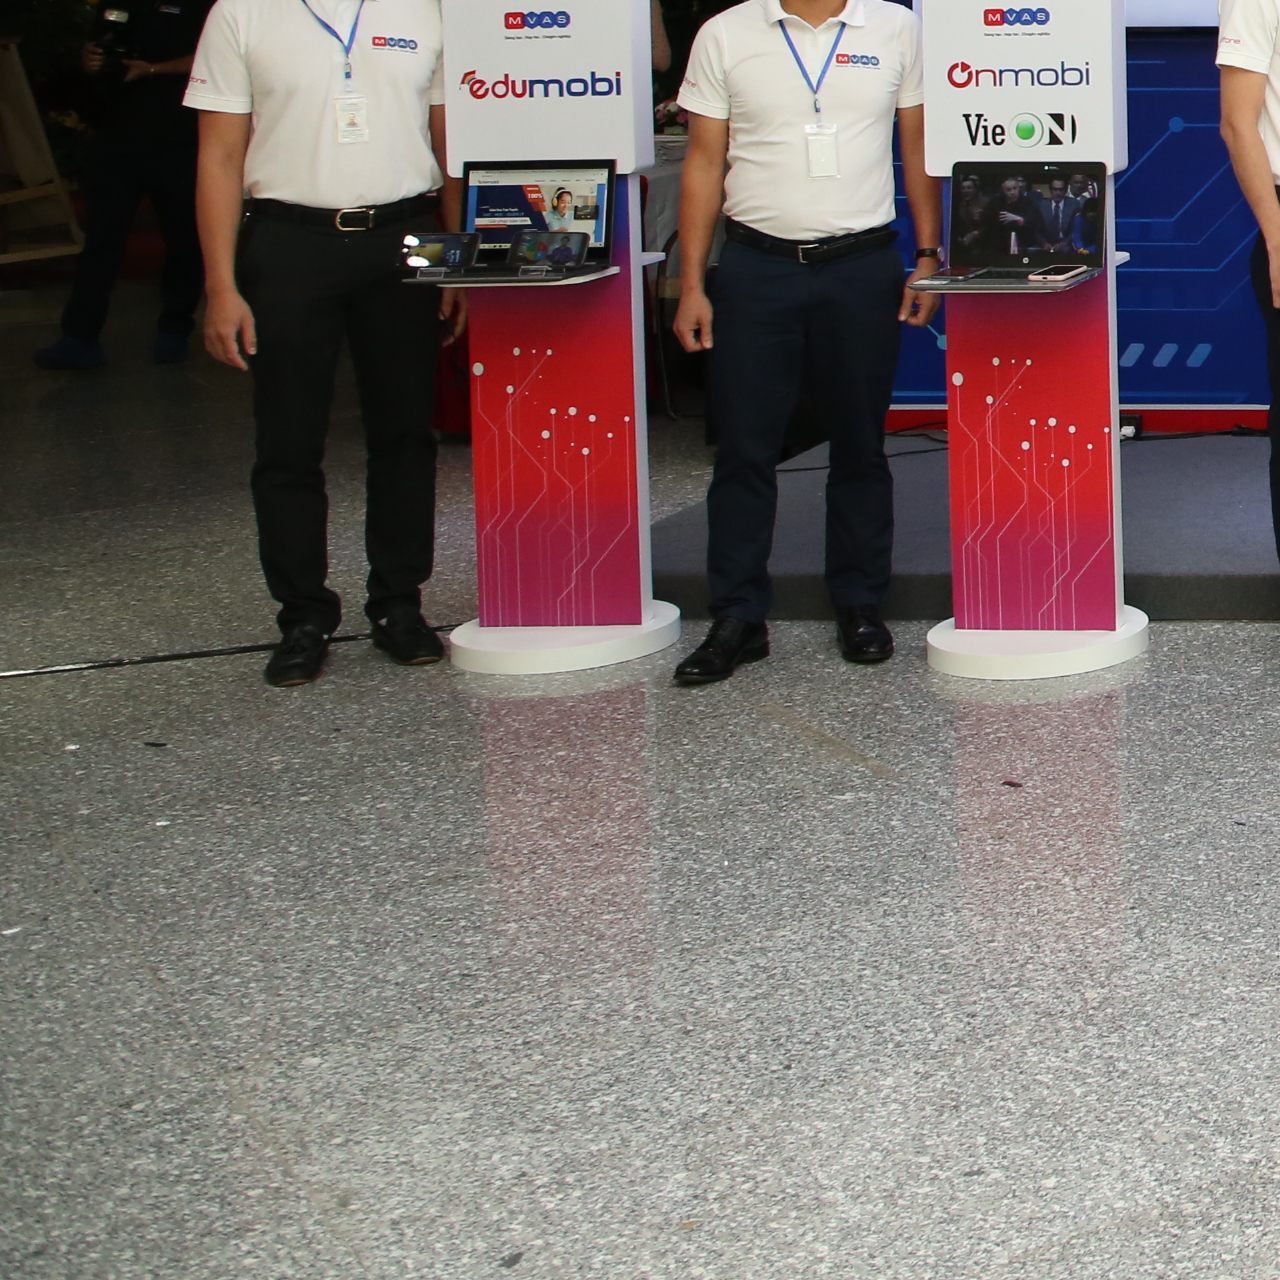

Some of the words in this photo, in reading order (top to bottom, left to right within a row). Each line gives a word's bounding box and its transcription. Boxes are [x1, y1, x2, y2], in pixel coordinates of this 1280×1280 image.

[507, 14, 568, 26] MVAS
[986, 11, 1048, 23] MVAS
[947, 61, 1090, 88] Onmobi
[466, 71, 622, 99] edumobi
